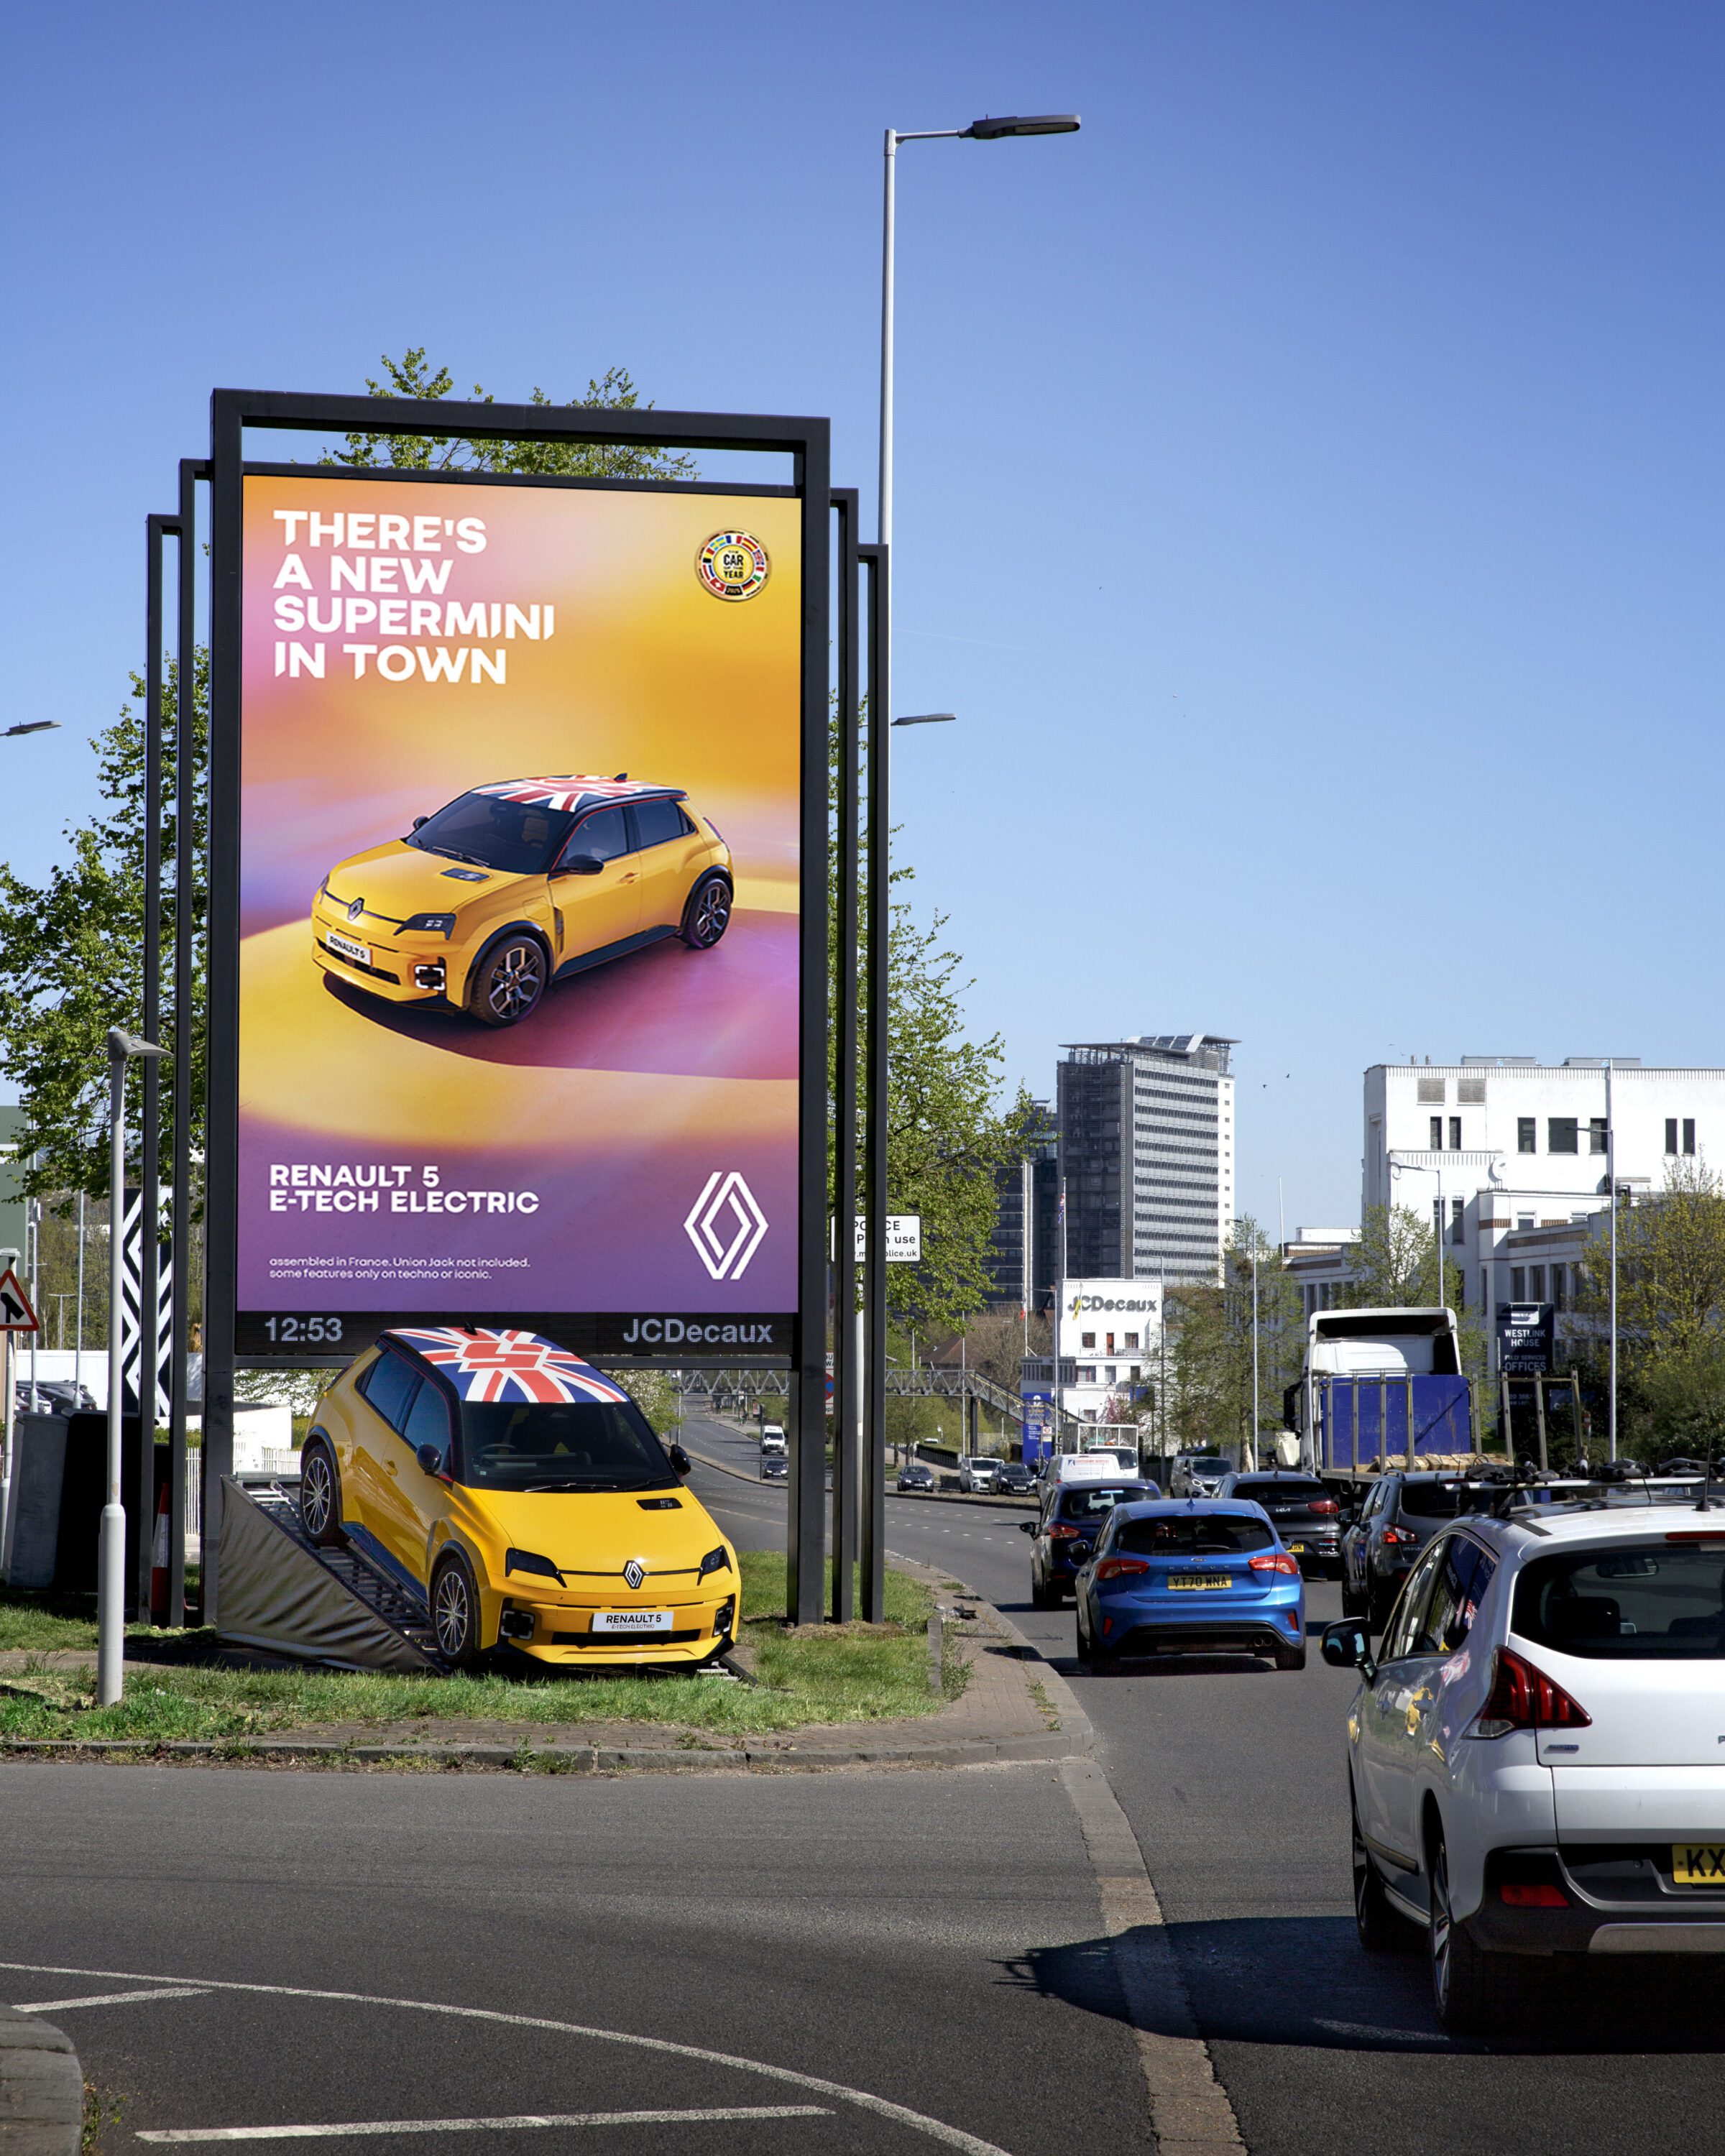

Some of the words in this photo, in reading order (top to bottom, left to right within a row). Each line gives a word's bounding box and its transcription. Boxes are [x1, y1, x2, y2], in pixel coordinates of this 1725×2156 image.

[273, 510, 487, 554] THERE'S
[723, 554, 744, 566] CAR
[272, 553, 313, 590] A
[331, 555, 454, 595] NEW
[274, 595, 554, 640] SUPERMINI
[275, 642, 326, 679] IN
[343, 644, 506, 684] TOWN
[270, 1164, 412, 1187] RENAULT
[422, 1166, 440, 1188] 5
[270, 1190, 379, 1212] E-TECH
[391, 1191, 540, 1214] ELECTRIC
[269, 1257, 335, 1266] assembled
[336, 1257, 347, 1266] in
[349, 1258, 392, 1267] France.
[392, 1258, 427, 1267] Union
[428, 1258, 455, 1267] Jack
[456, 1258, 477, 1267] not
[477, 1258, 531, 1268] included.
[269, 1269, 302, 1279] some
[303, 1268, 354, 1279] features
[354, 1269, 380, 1281] only
[397, 1269, 439, 1279] techno
[441, 1271, 453, 1279] or
[454, 1269, 493, 1279] iconic.
[1067, 1295, 1157, 1312] JCDecaux
[264, 1317, 343, 1342] 12:53
[623, 1317, 774, 1344] JCDecaux
[1504, 1362, 1547, 1371] OFFICES
[1173, 1577, 1202, 1587] YT70
[1205, 1576, 1227, 1587] WNA
[656, 1614, 661, 1623] 5
[1686, 1849, 1725, 1877] KX
